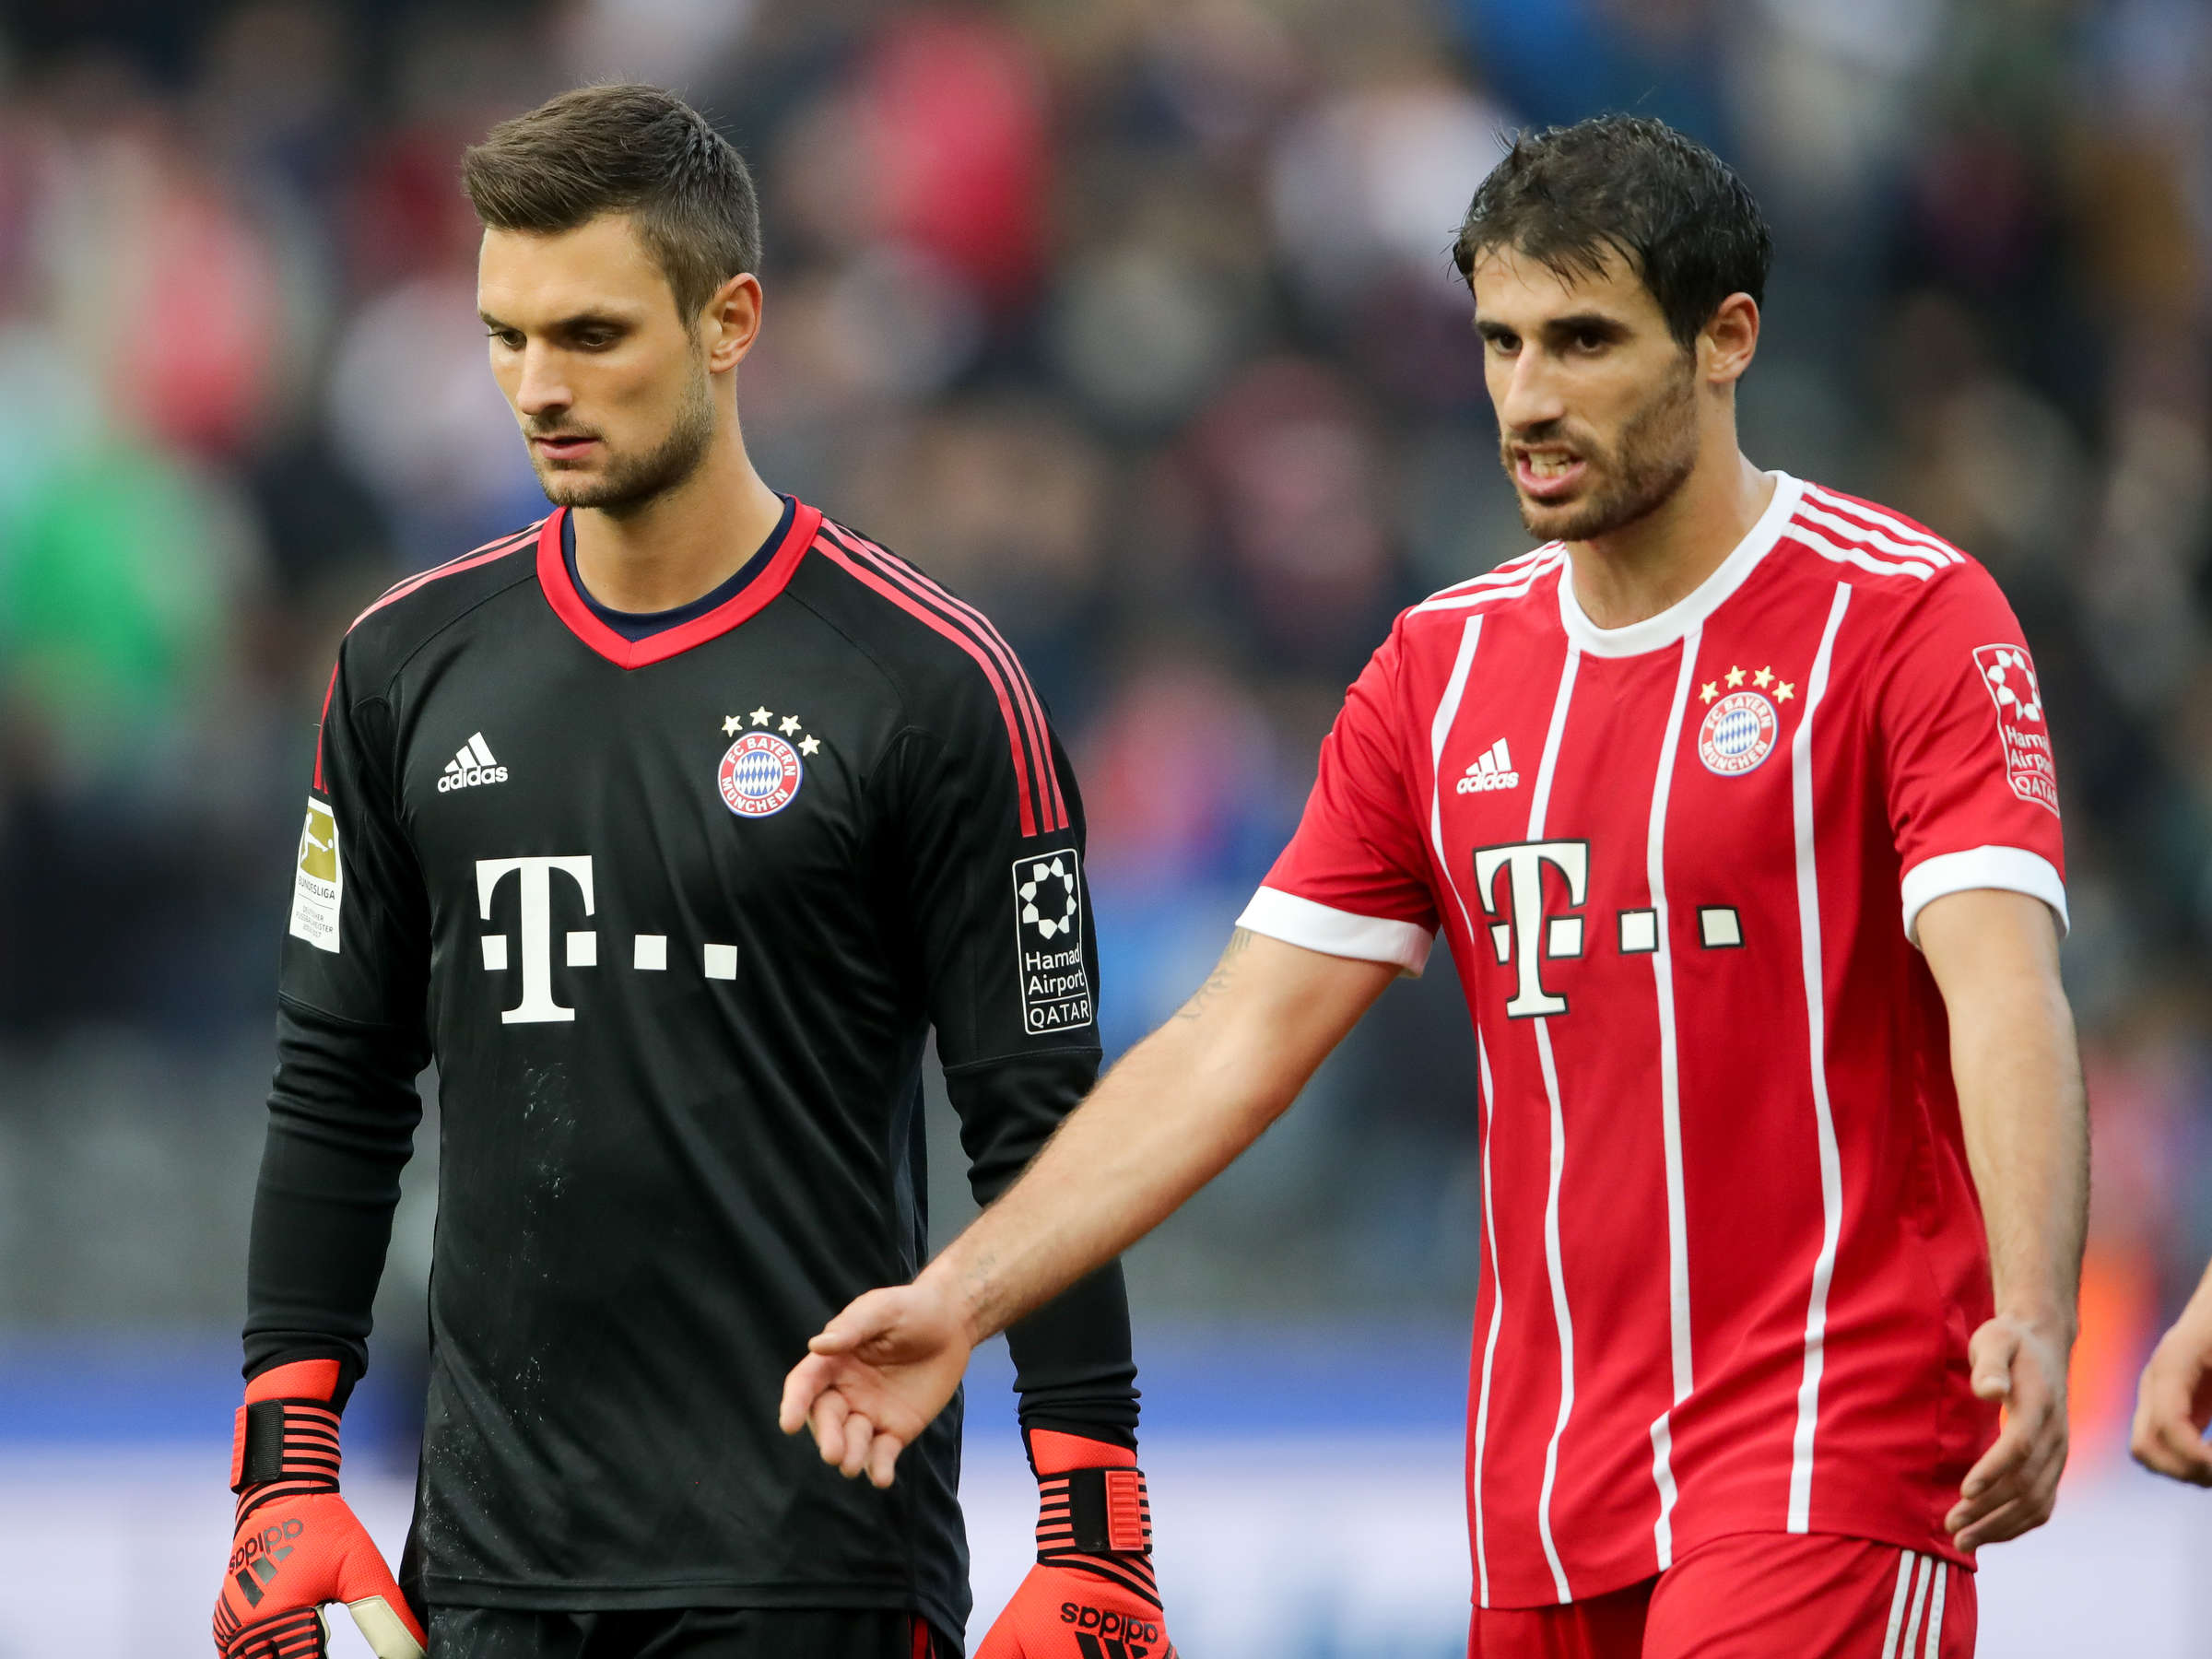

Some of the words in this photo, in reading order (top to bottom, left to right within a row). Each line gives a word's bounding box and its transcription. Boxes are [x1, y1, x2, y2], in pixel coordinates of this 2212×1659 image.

[1724, 696, 1771, 729] BAYERN
[726, 745, 745, 765] FC
[746, 737, 797, 776] BAYERN
[436, 763, 509, 794] adidas
[1456, 770, 1520, 795] adidas
[1025, 942, 1081, 972] Hamad
[1028, 969, 1086, 997] Airport
[1030, 999, 1090, 1029] QATAR
[229, 1518, 304, 1575] adidas
[1060, 1602, 1159, 1644] adidas
